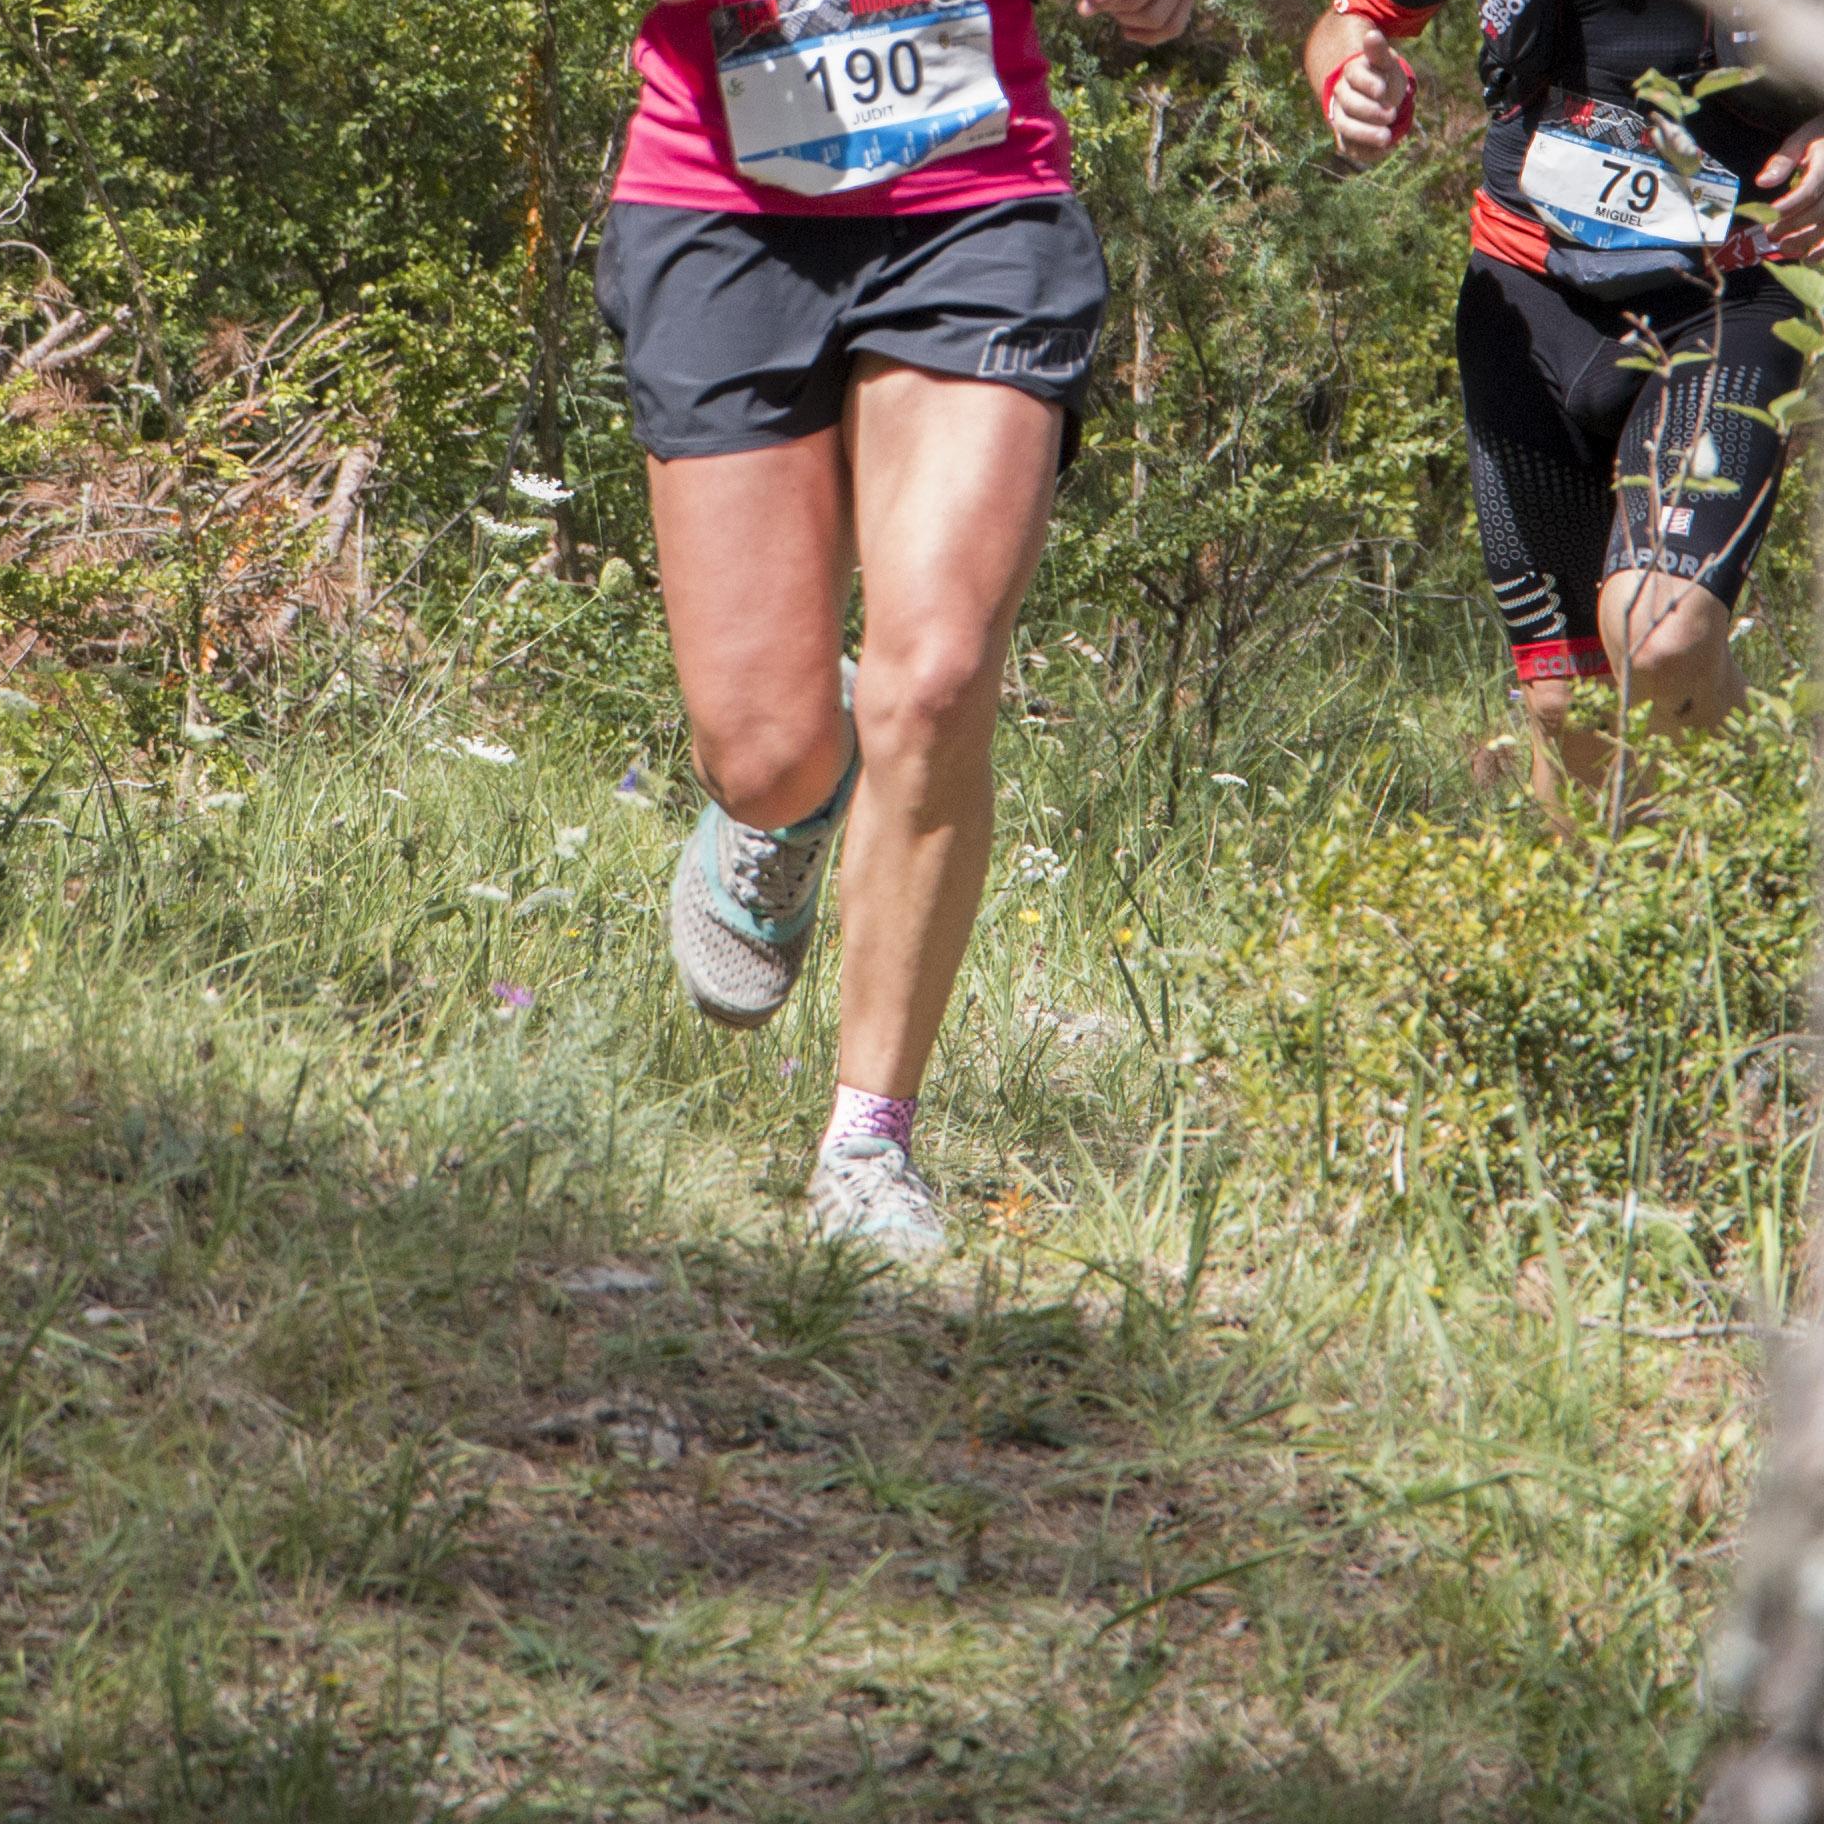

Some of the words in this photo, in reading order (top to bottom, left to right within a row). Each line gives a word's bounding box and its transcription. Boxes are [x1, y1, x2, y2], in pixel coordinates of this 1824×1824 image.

[805, 39, 924, 112] 190
[852, 104, 895, 126] JUDIT
[1598, 160, 1659, 214] 79
[1594, 206, 1643, 227] MIGUEL
